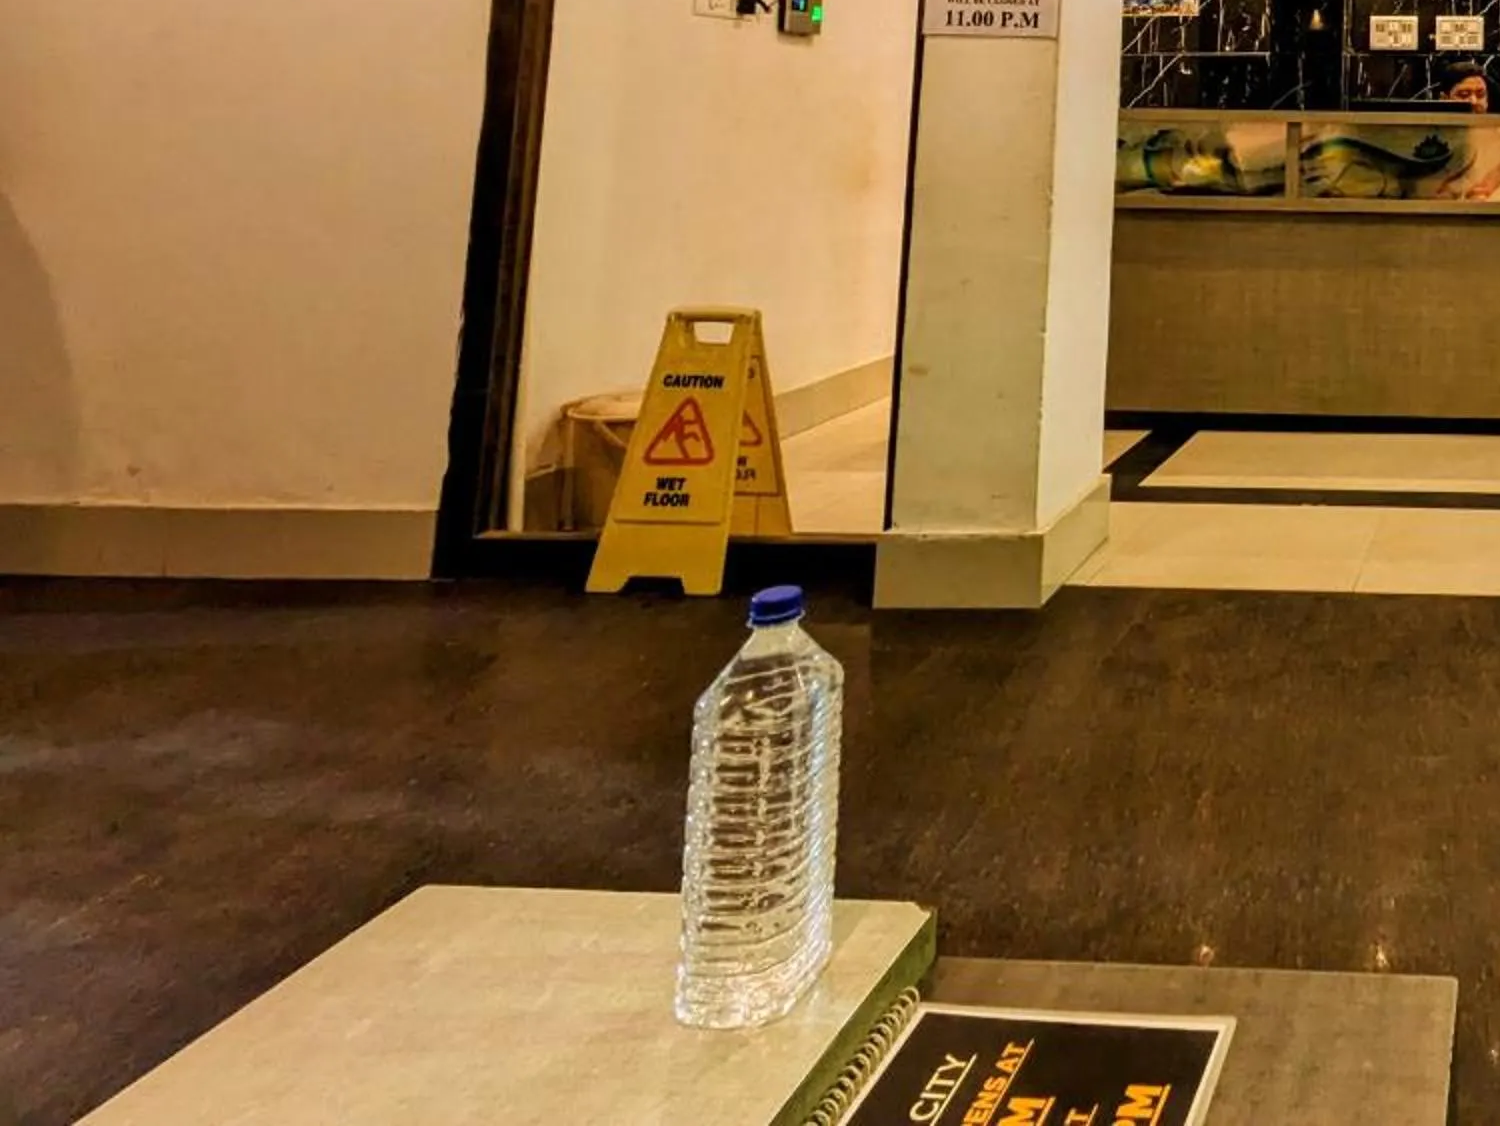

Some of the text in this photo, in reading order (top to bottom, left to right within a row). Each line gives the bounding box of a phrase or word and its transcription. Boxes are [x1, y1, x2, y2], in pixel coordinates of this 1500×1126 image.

[945, 10, 1040, 28] 11.00 P.M
[663, 374, 725, 389] CAUTION
[656, 477, 687, 491] WET
[643, 491, 690, 507] FLOOR
[995, 1040, 1026, 1074] AT
[909, 1054, 966, 1121] CITY
